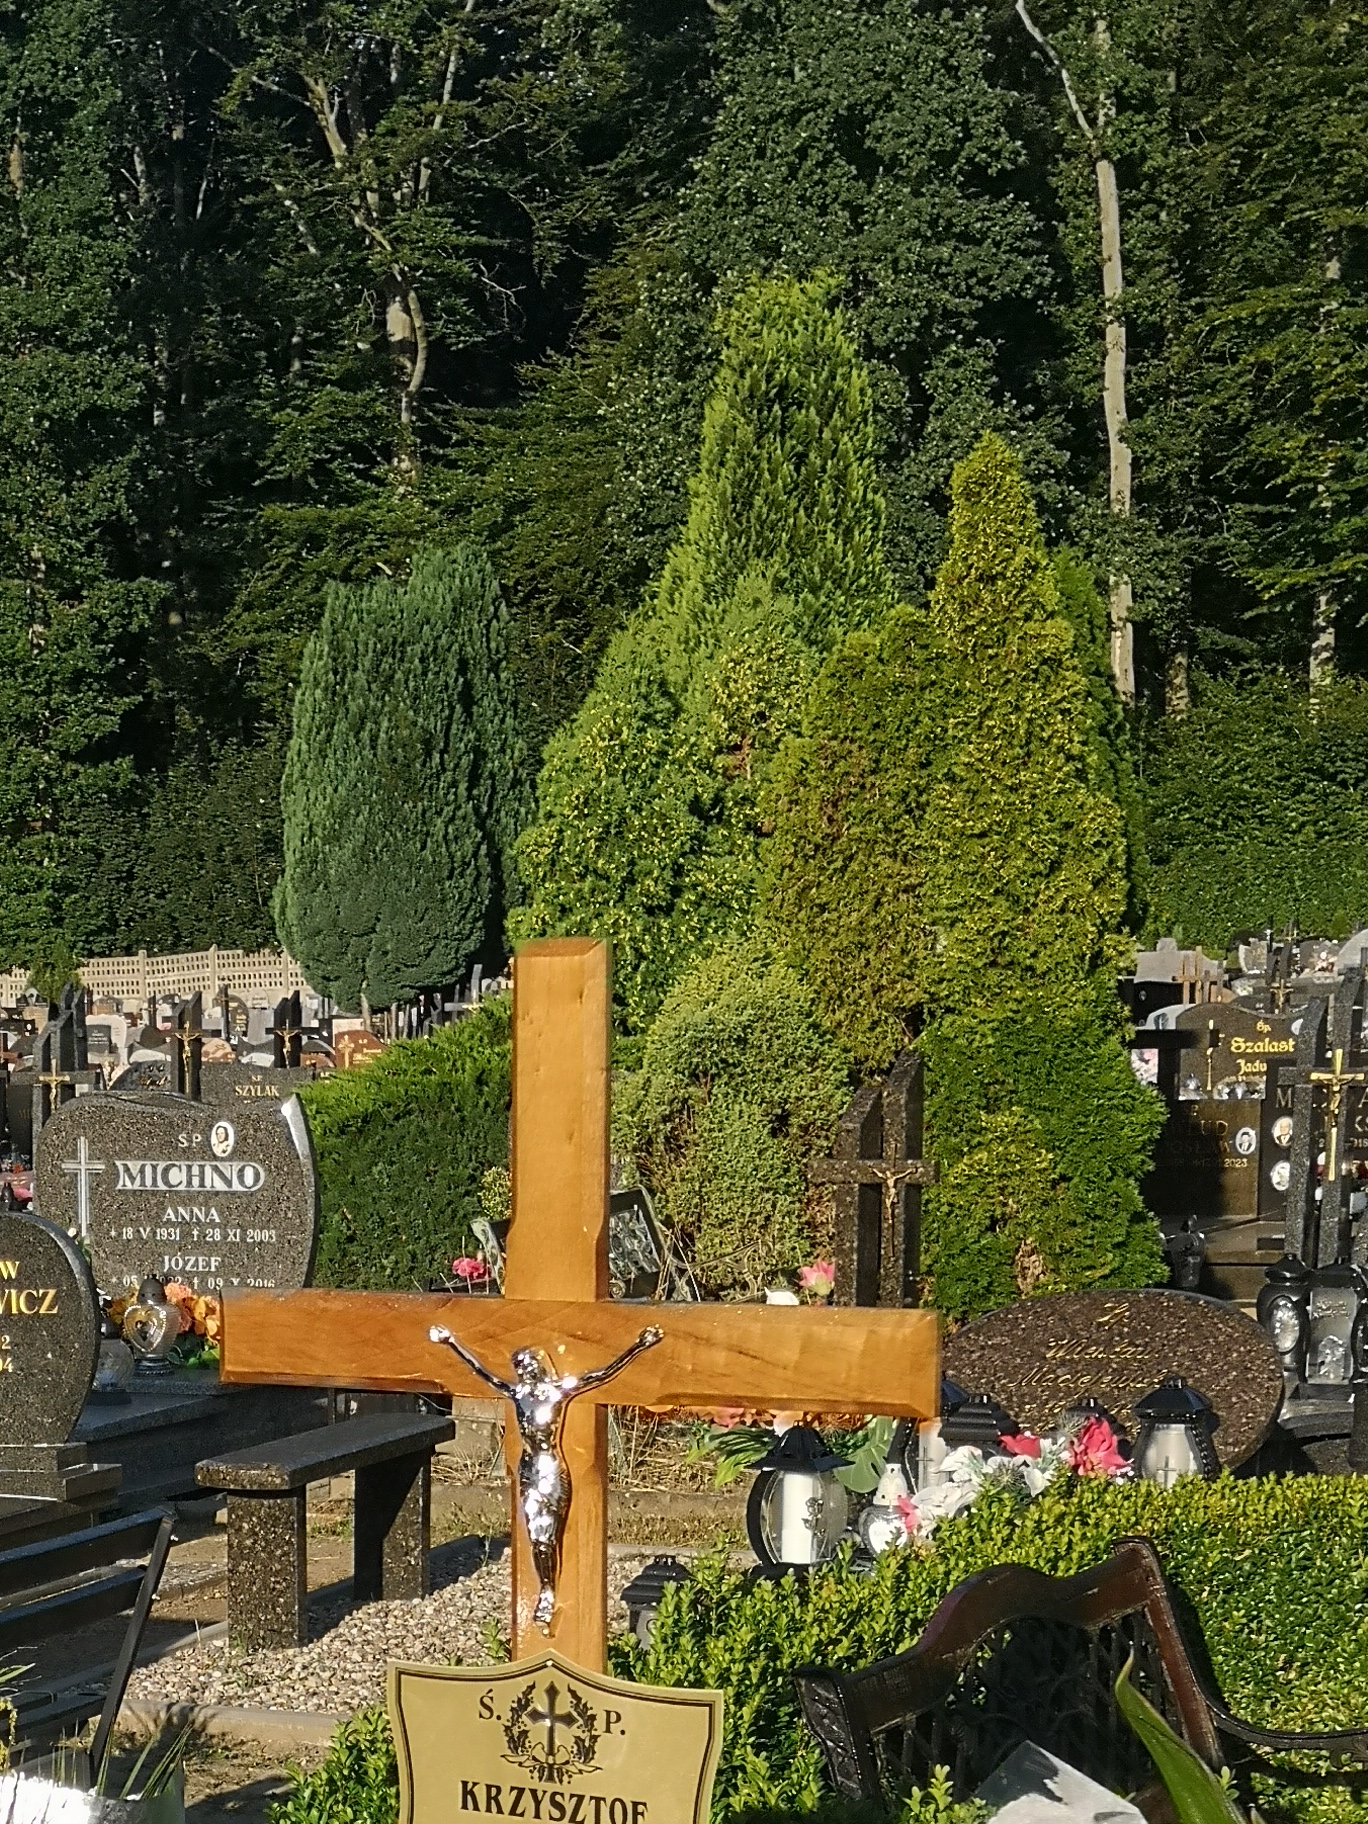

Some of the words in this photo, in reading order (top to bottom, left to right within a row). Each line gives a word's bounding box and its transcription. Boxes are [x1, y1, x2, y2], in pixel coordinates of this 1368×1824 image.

[234, 1085, 280, 1097] SZYLAK
[119, 1162, 262, 1190] MICHNO
[163, 1207, 221, 1223] ANNA
[122, 1227, 133, 1240] 18
[139, 1227, 151, 1240] V
[156, 1227, 181, 1241] 1931
[205, 1228, 221, 1241] 28
[227, 1229, 241, 1242] XI
[246, 1229, 276, 1242] 2003
[164, 1250, 222, 1272] JÓZEF
